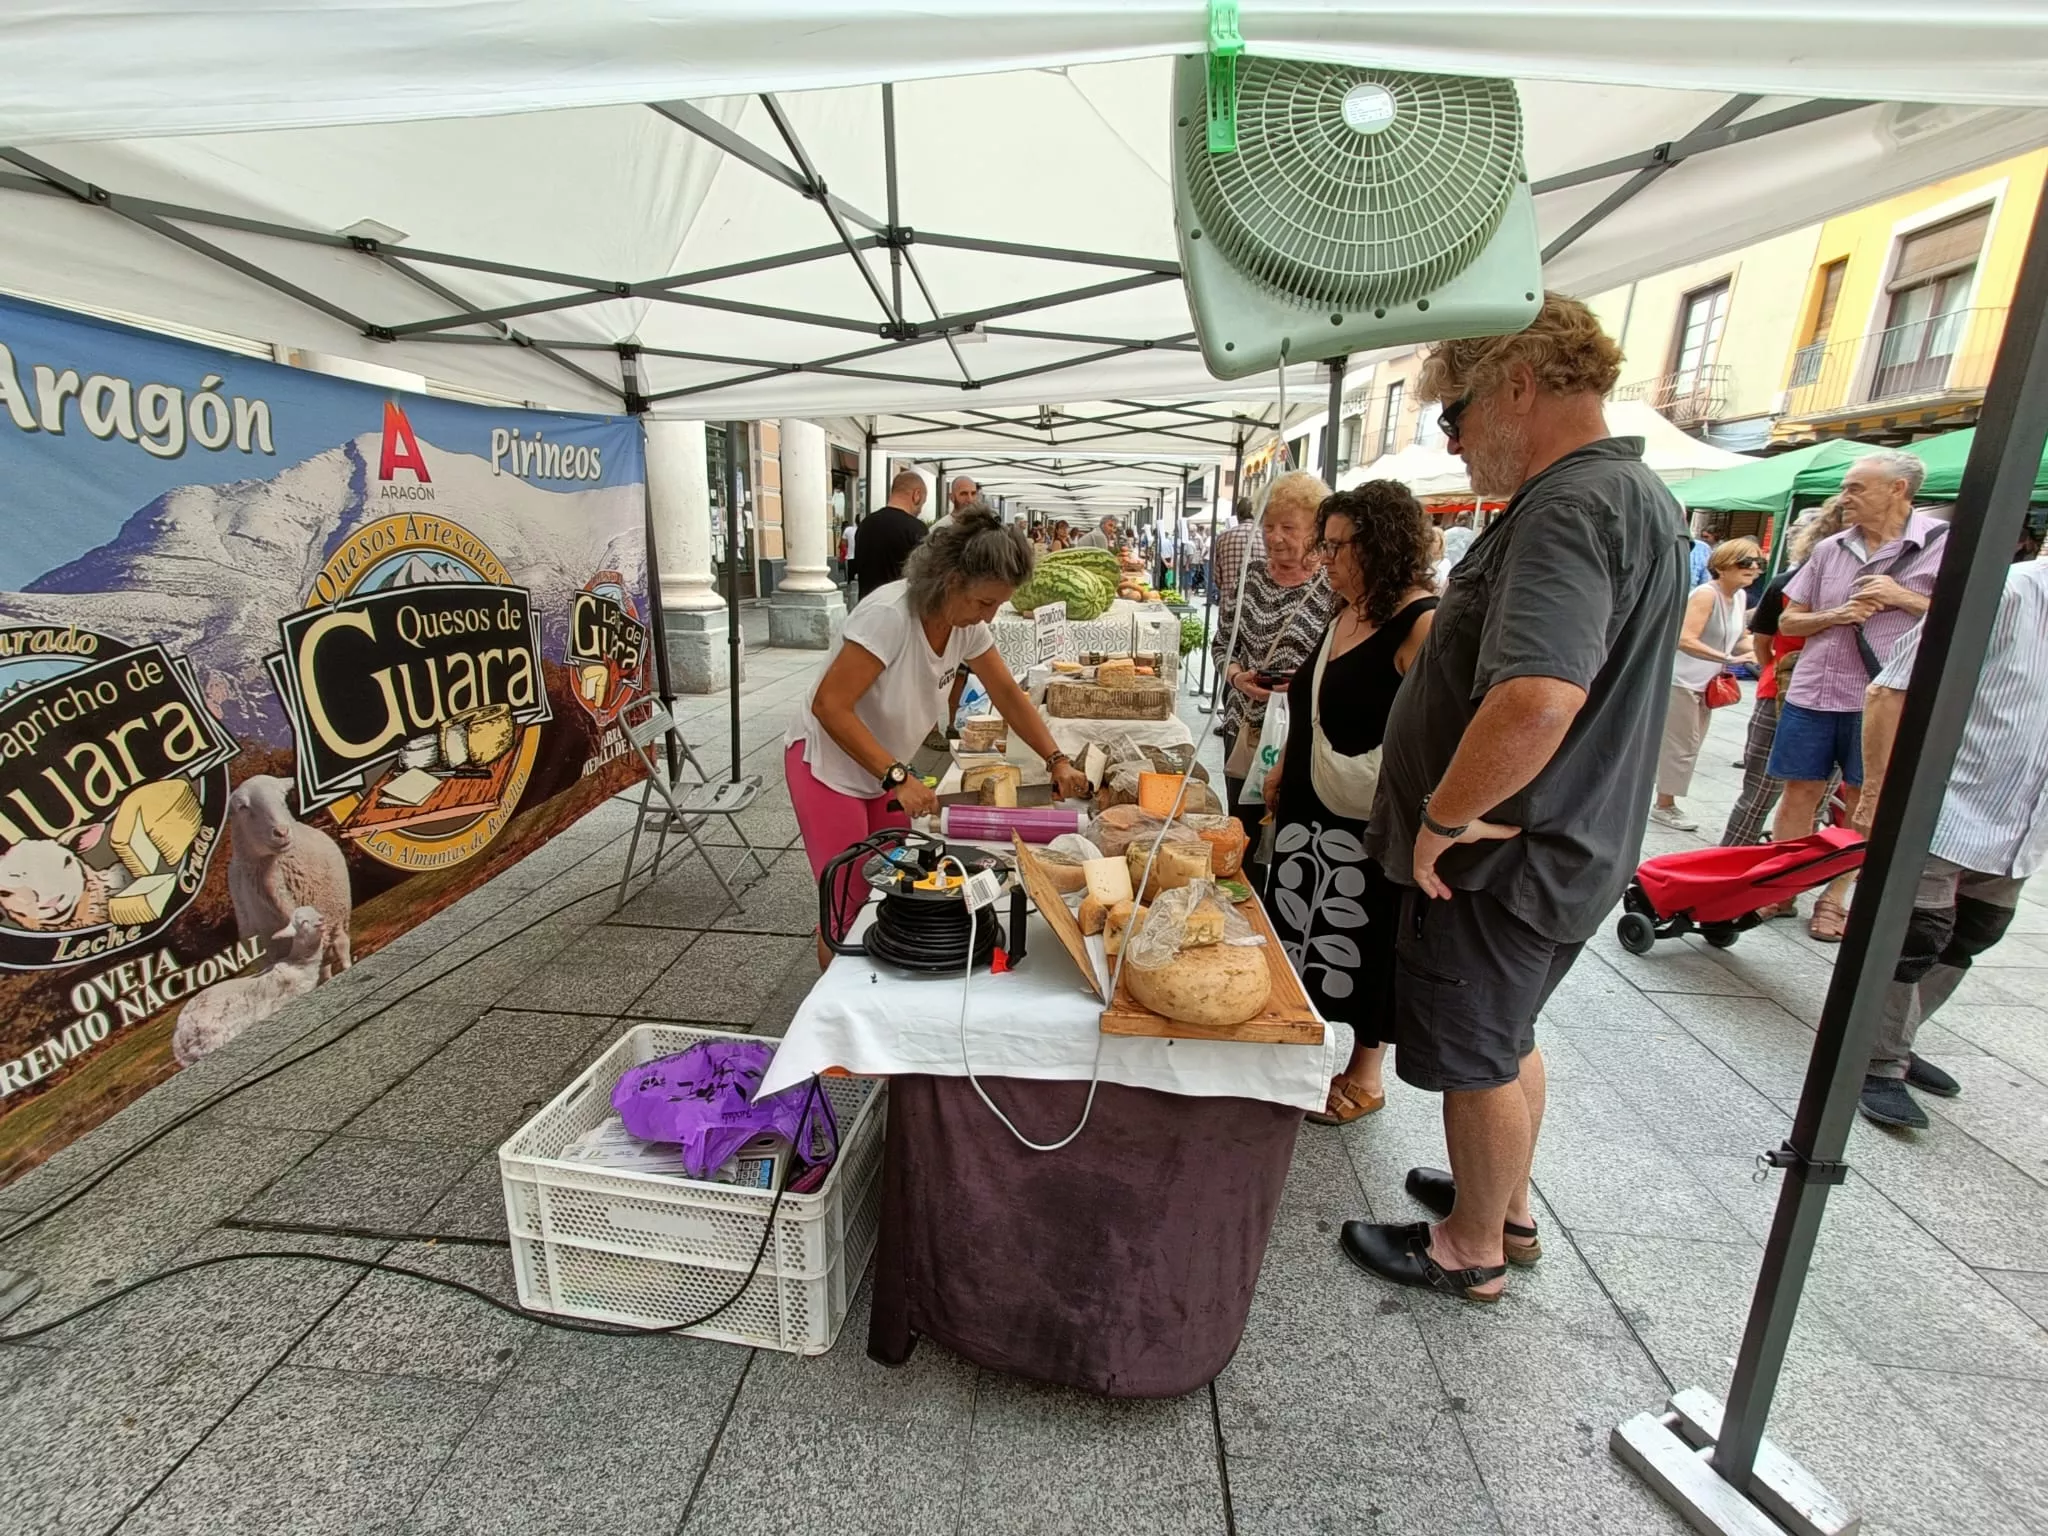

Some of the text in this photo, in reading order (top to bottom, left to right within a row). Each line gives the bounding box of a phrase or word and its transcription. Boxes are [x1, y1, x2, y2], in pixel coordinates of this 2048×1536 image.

[379, 401, 432, 482] A
[381, 483, 435, 501] ARAGÓN
[315, 512, 507, 612] Quesos Artesanos
[397, 598, 522, 648] Quesos de
[625, 625, 641, 645] de
[0, 660, 164, 767] apricho de
[299, 607, 534, 759] Guara
[366, 828, 395, 858] Las
[397, 842, 466, 866] Almunias
[52, 826, 215, 962] Leche Cruda
[72, 948, 182, 1015] OVEJA
[115, 935, 267, 1027] NACIONAL
